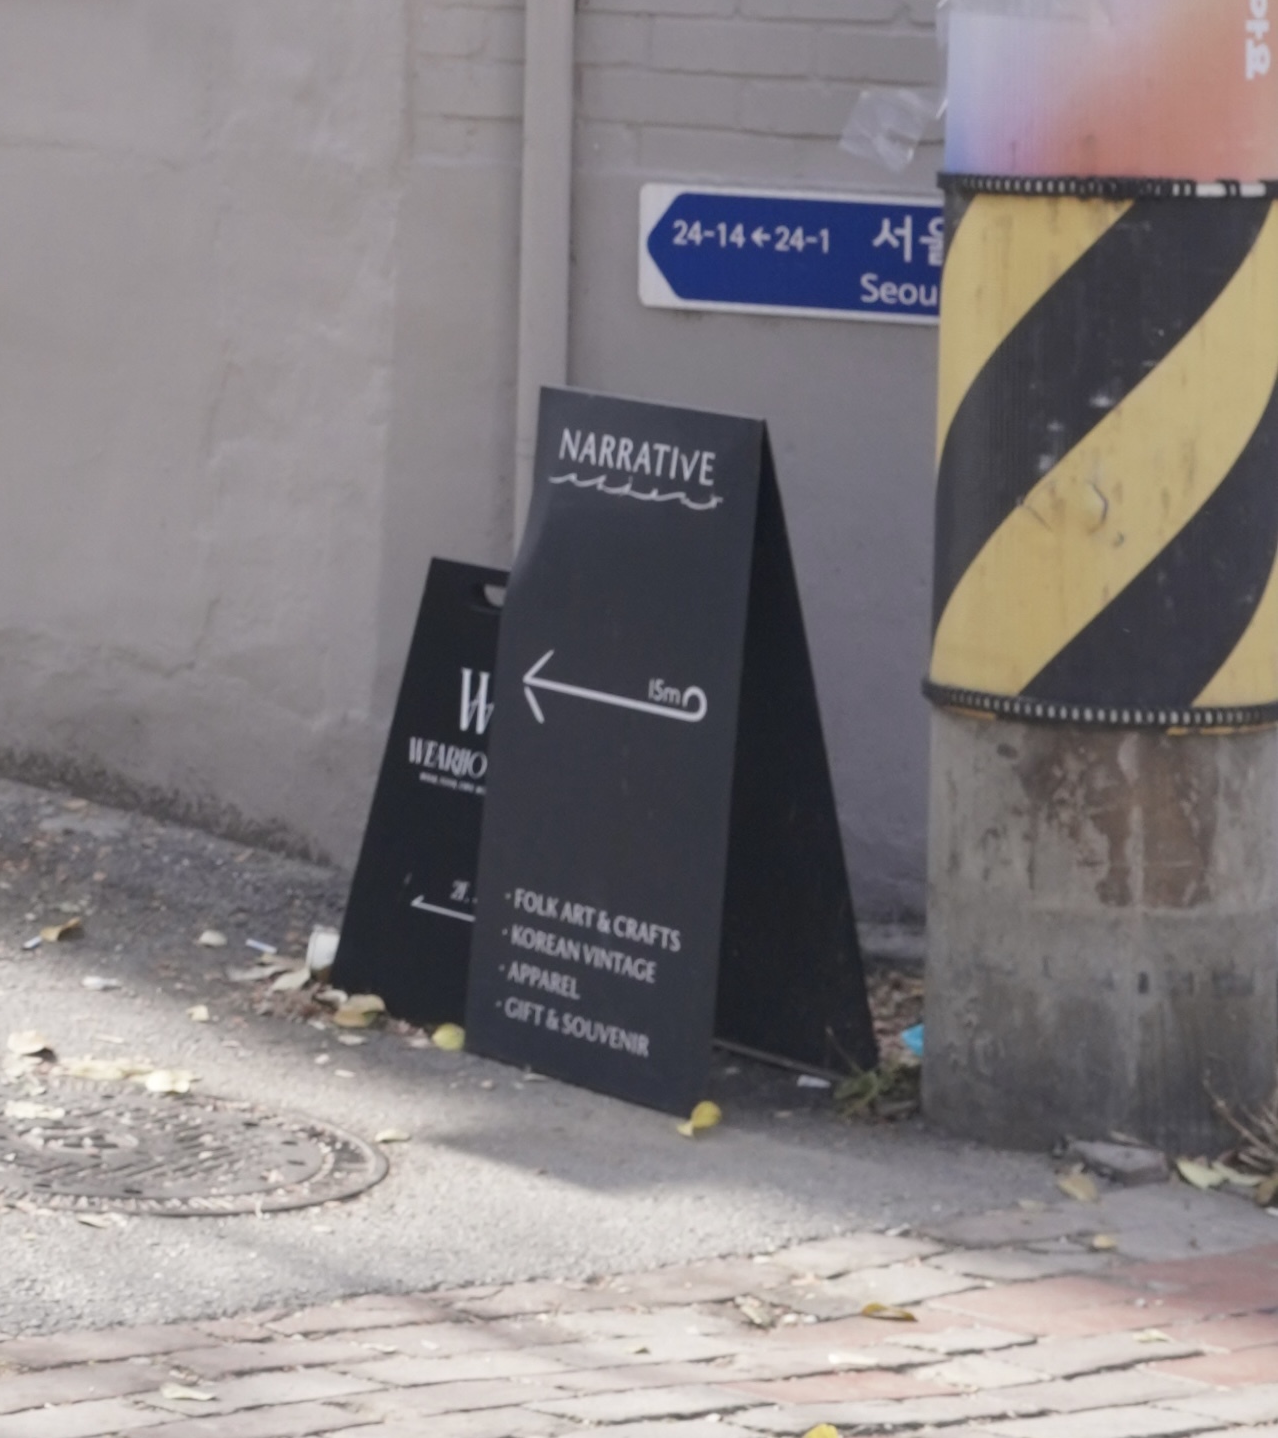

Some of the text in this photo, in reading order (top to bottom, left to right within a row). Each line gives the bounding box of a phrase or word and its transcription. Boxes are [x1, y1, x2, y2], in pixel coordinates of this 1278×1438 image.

[672, 219, 746, 249] 24-14
[774, 226, 831, 255] 24-1
[557, 427, 717, 487] NARRATIVE
[514, 888, 682, 952] FOLK ART & CRAFTS
[507, 960, 581, 1000] APPAREL
[510, 924, 657, 984] KOREAN VINTAGE
[503, 996, 650, 1058] GIFT & SOUVENIR
